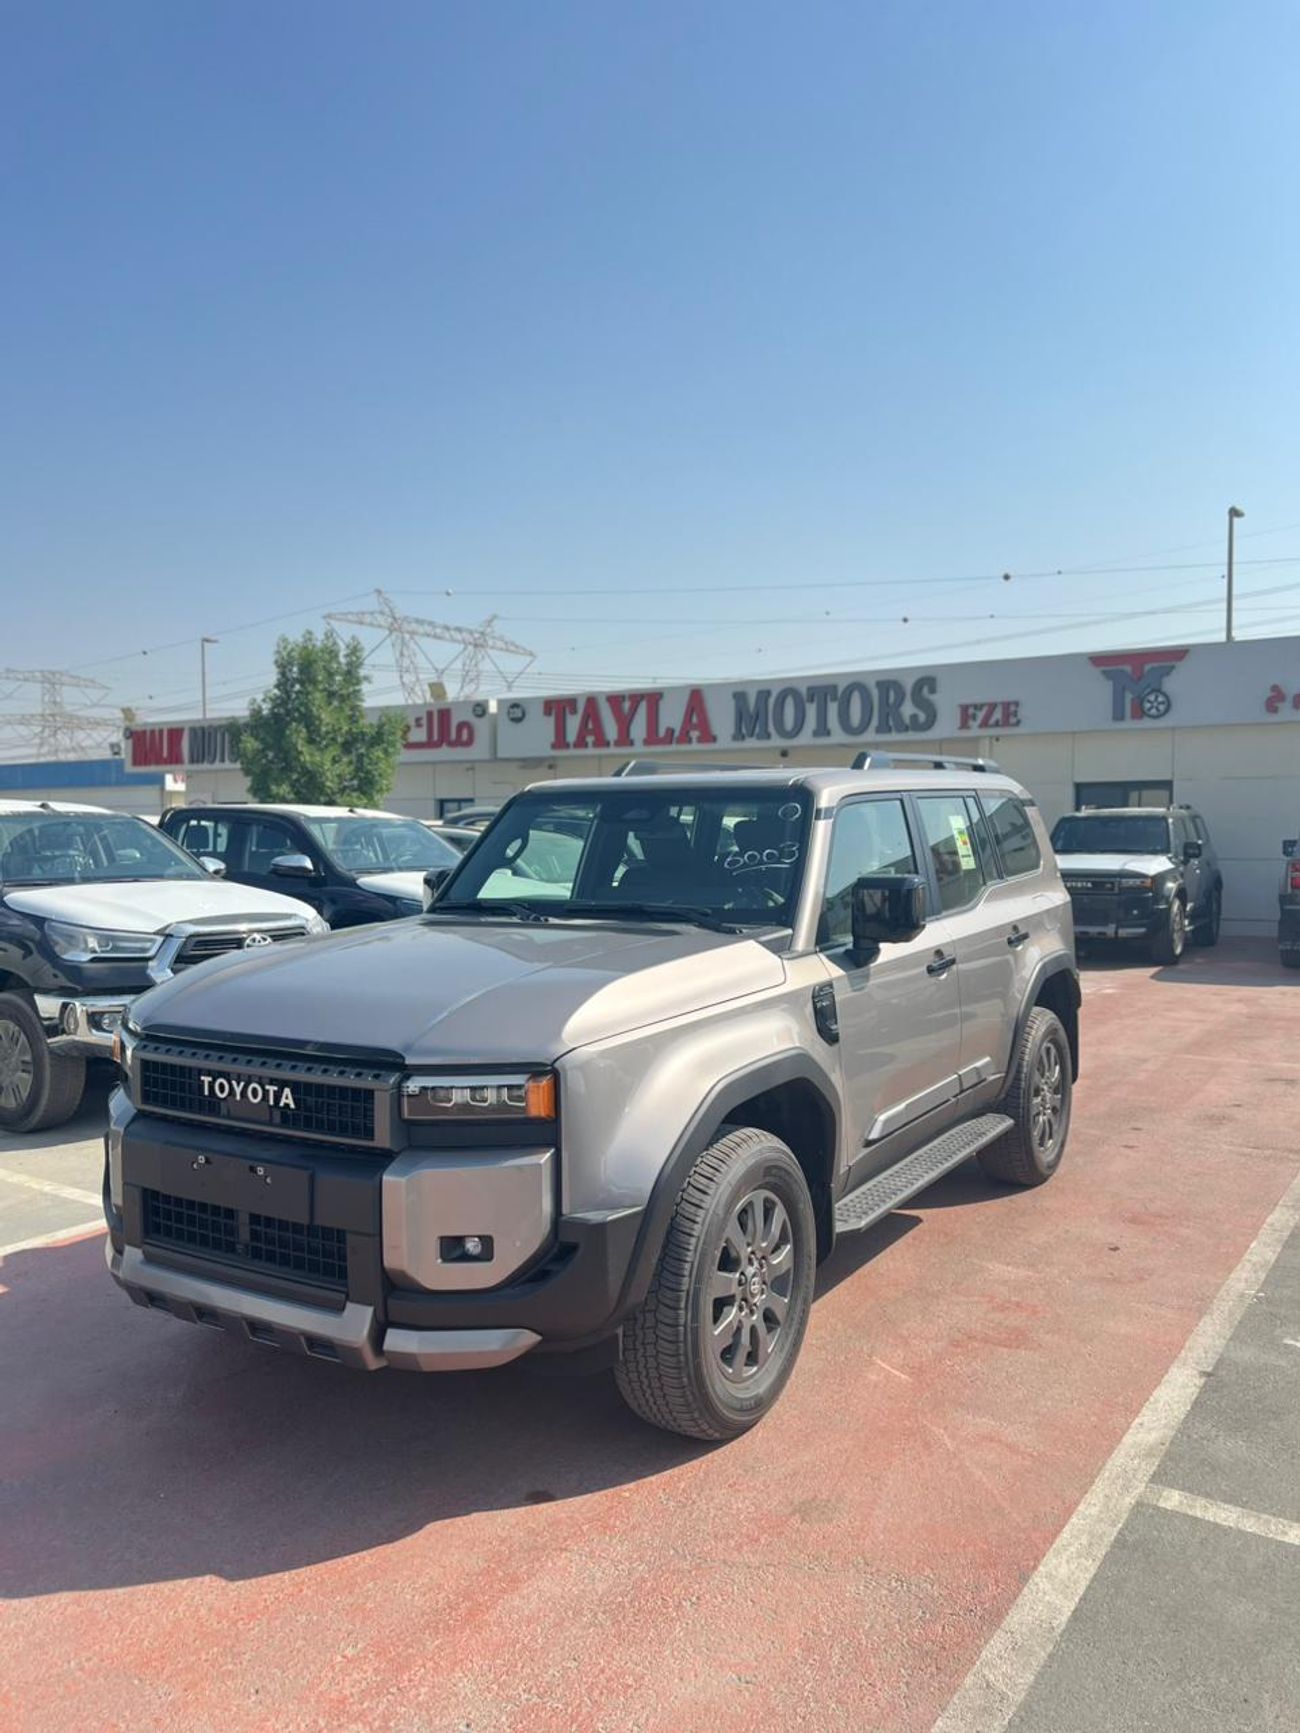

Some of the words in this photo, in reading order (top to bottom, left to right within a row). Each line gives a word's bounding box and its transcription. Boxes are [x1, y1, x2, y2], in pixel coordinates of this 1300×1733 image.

[544, 688, 716, 751] TAYLA
[731, 676, 938, 742] MOTORS
[958, 701, 1021, 730] FZE
[131, 727, 185, 767] MALIK
[201, 1076, 296, 1109] TOYOTA
